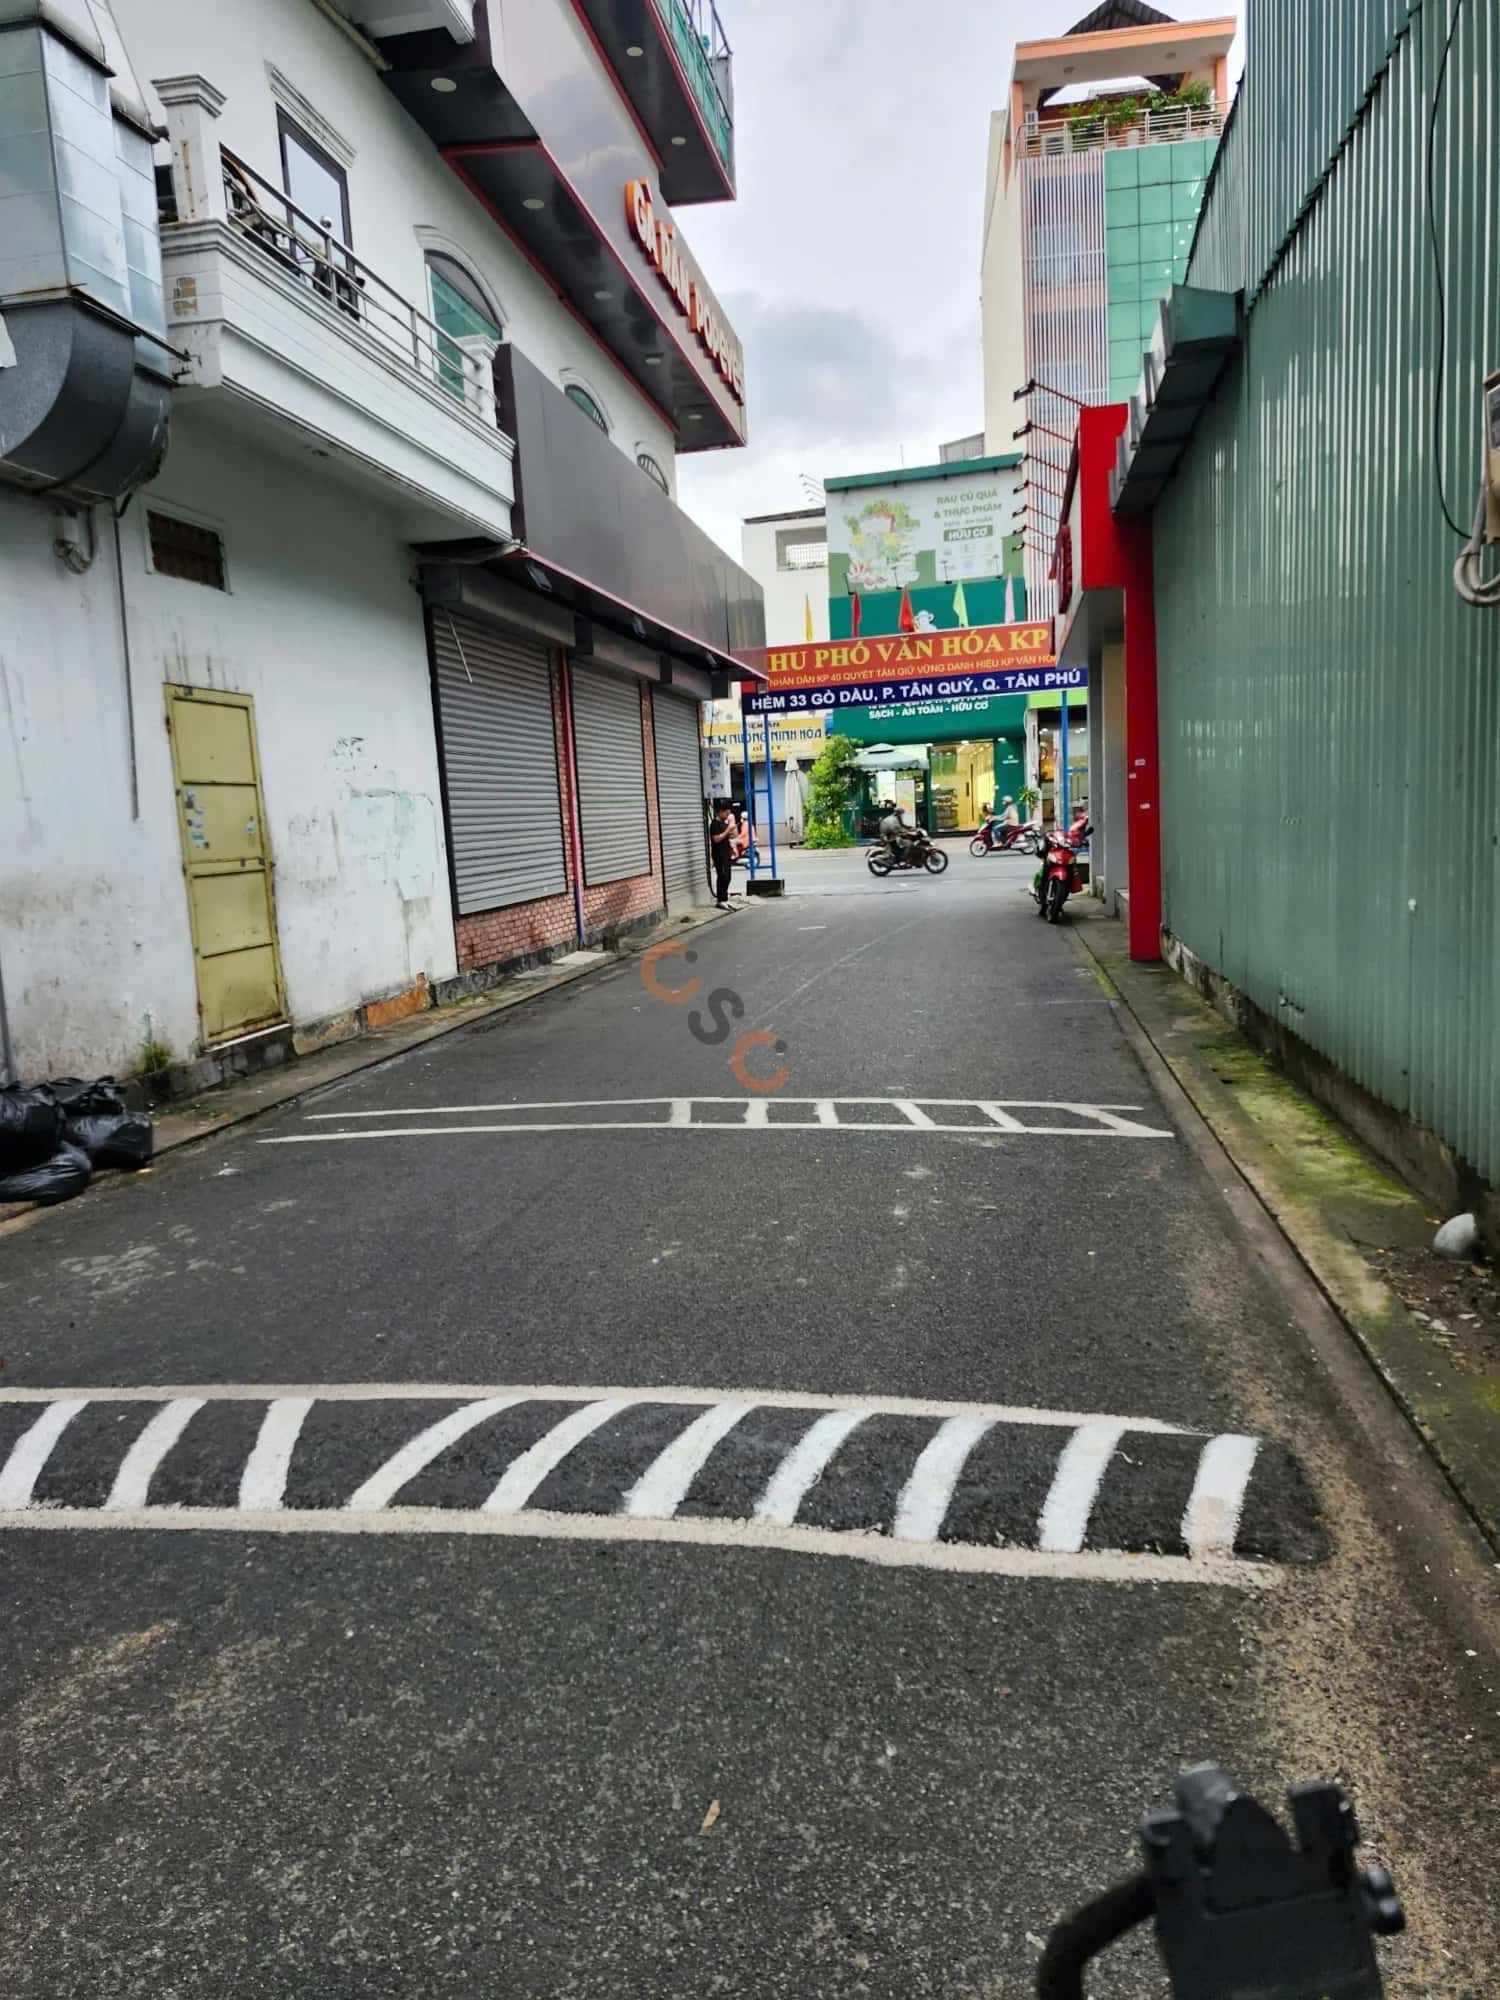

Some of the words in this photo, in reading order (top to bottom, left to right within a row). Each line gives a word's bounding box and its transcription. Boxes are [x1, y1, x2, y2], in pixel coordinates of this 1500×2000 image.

[936, 495, 957, 505] RAU
[768, 651, 806, 672] HU
[814, 640, 870, 668] PHỐ
[876, 637, 934, 662] VĂN
[941, 630, 1004, 657] HÓA
[1008, 629, 1049, 650] KP
[796, 674, 816, 685] DÂN
[817, 674, 829, 683] KP
[830, 673, 841, 682] 40
[875, 667, 897, 678] TÂM
[917, 661, 945, 674] VỮNG
[947, 659, 974, 671] DANH
[789, 695, 807, 707] 33
[811, 690, 835, 705] GÒ
[883, 687, 896, 699] P.
[900, 682, 933, 697] TÂN
[937, 677, 978, 694] QUÝ,
[982, 678, 1000, 691] Q.
[1005, 673, 1040, 689] TÂN
[1044, 668, 1080, 685] PHÚ
[869, 709, 894, 720] SẠCH
[902, 706, 915, 716] AN
[917, 704, 943, 715] TOÀN
[951, 701, 972, 713] HỮU
